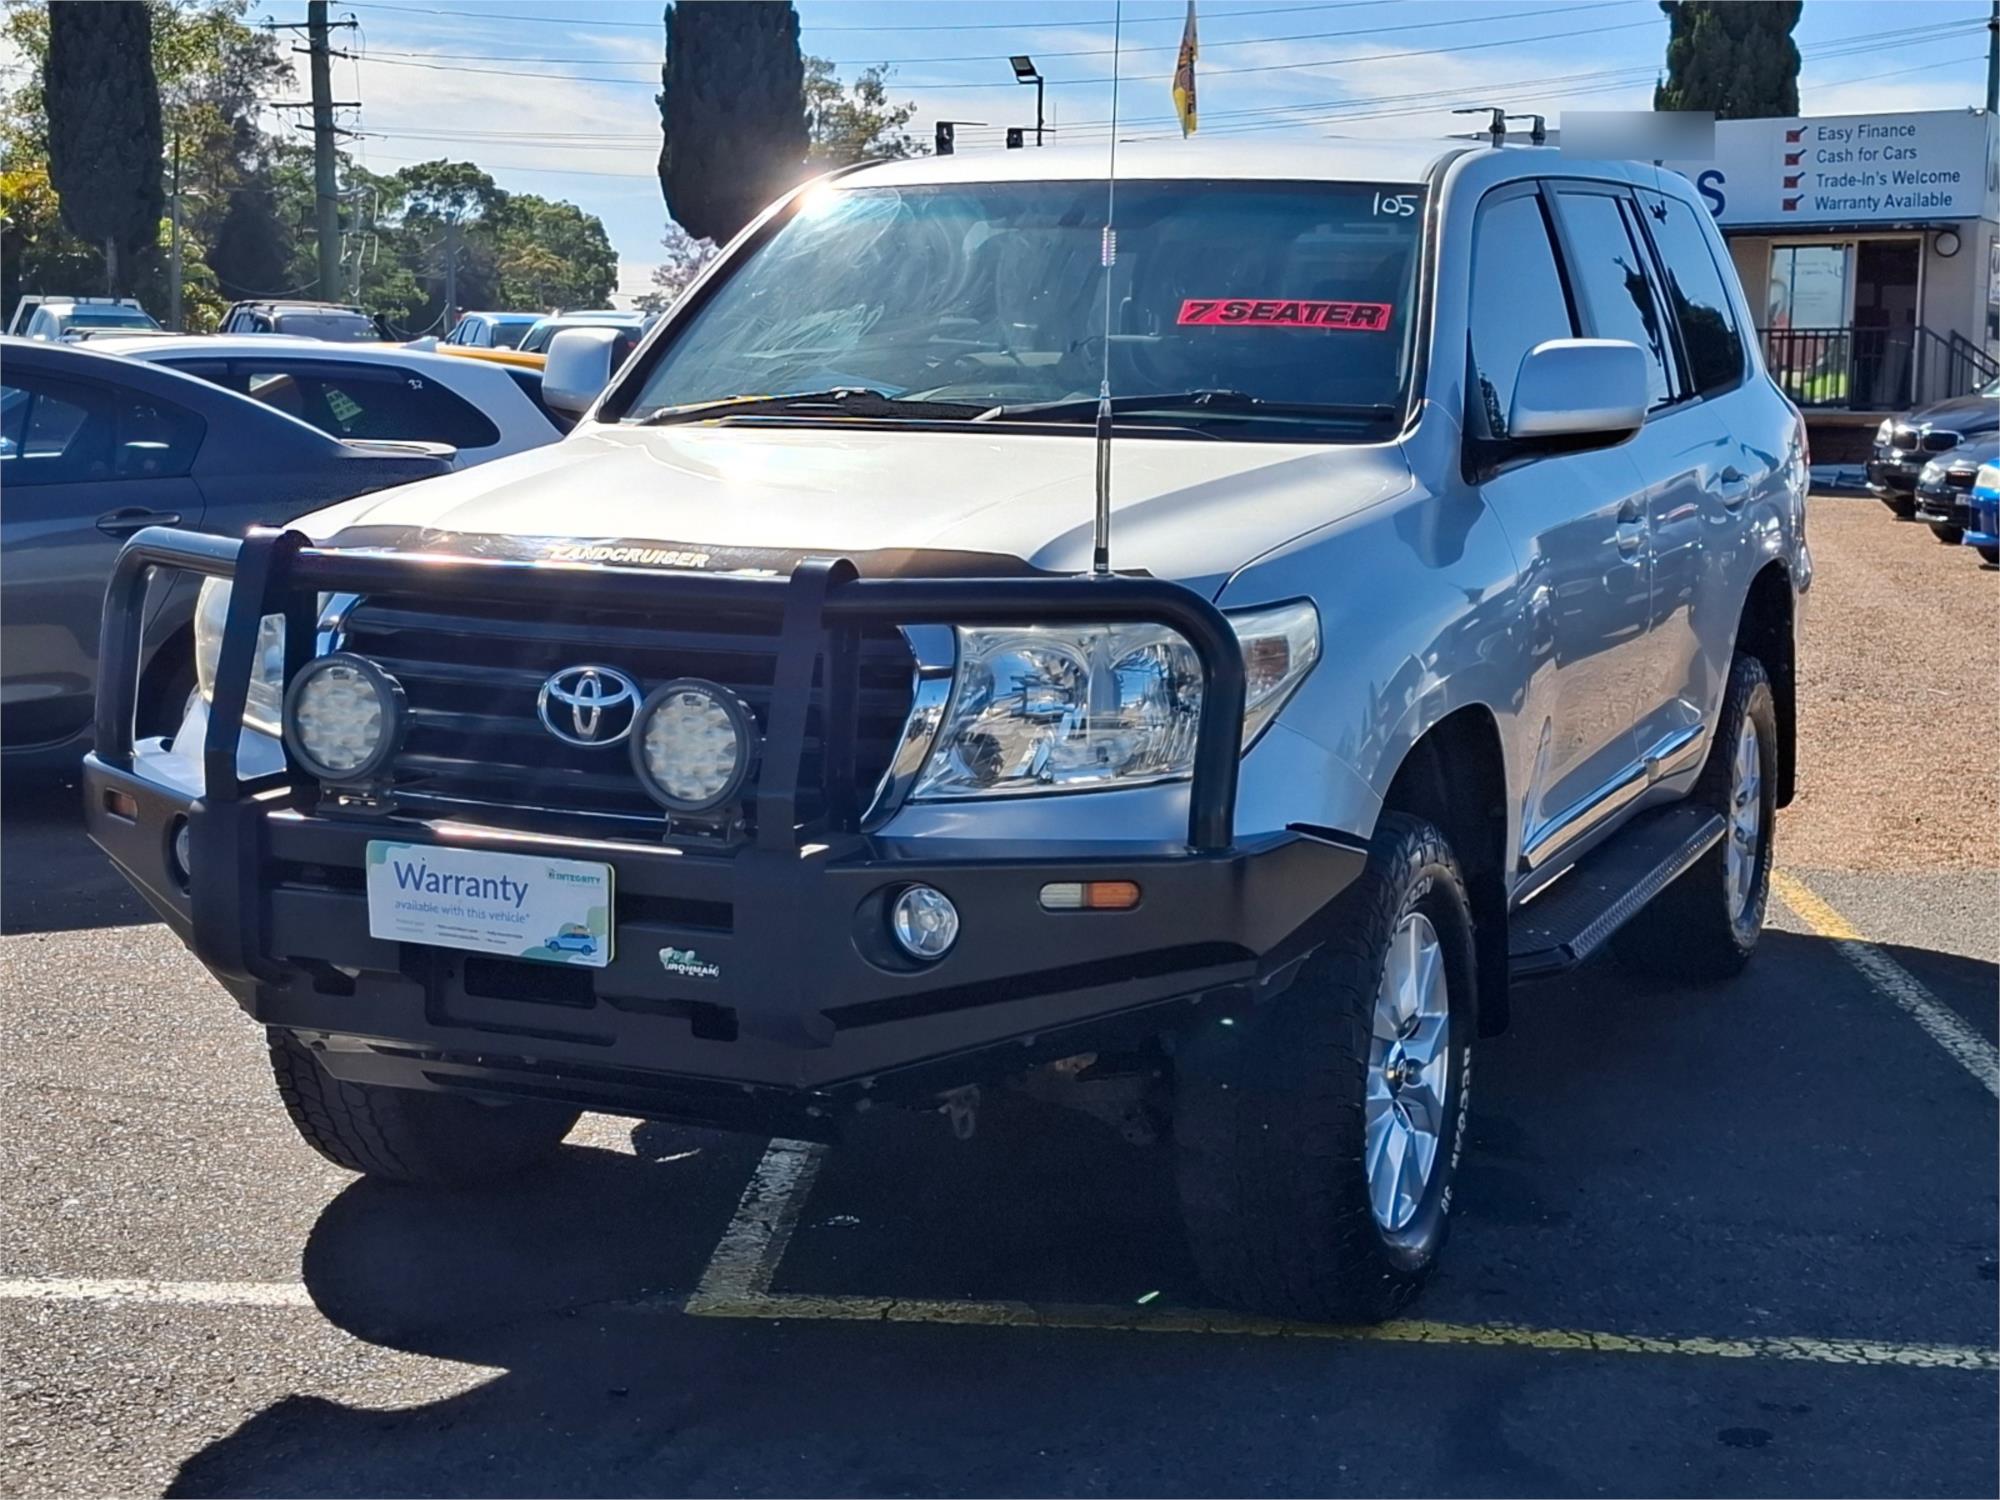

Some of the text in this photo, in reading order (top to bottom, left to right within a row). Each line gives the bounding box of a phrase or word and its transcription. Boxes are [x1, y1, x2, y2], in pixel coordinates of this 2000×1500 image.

[1817, 124, 1916, 143] Easy Finance
[1816, 145, 1917, 163] Cash for Cars
[1816, 170, 1961, 187] Trade-In's Welcome
[1373, 191, 1418, 216] 105
[1814, 192, 1953, 212] Warranty Available
[1185, 302, 1385, 328] 7 SEATER
[393, 860, 529, 909] Warranty
[395, 900, 439, 914] available
[441, 904, 465, 917] with
[467, 908, 487, 919] this
